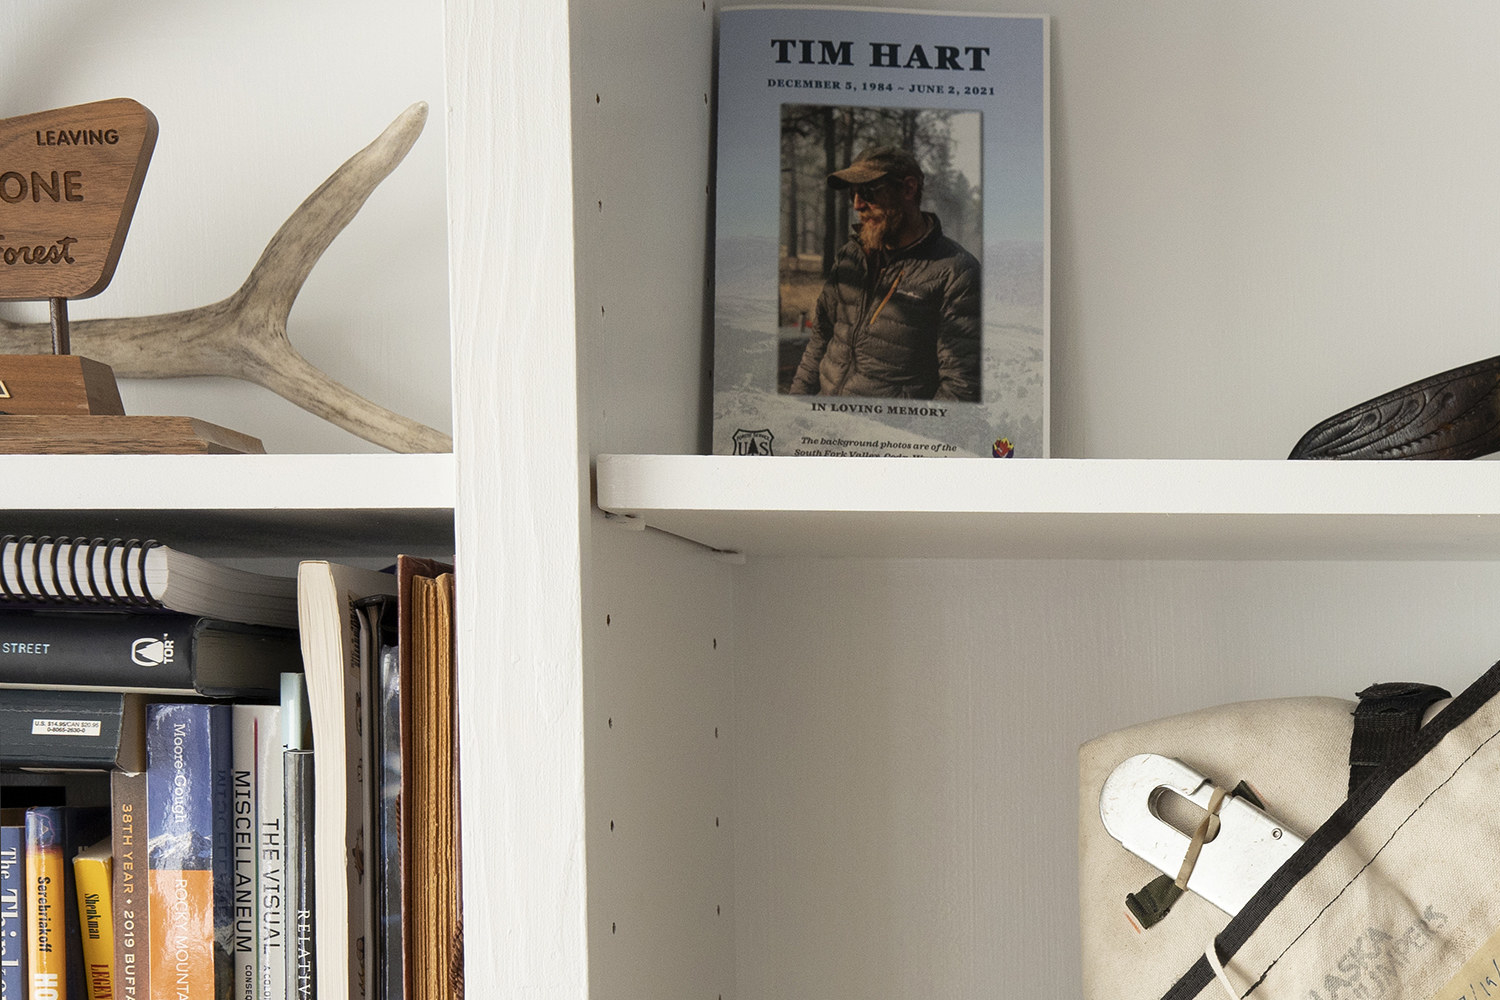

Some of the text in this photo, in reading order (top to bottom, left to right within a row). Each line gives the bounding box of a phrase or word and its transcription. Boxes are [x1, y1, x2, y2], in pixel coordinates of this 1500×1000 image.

[770, 38, 991, 72] TIM HART
[767, 78, 841, 90] DECEMBER
[844, 82, 857, 92] 5,
[861, 82, 893, 92] 1984
[908, 84, 945, 94] JUNE
[947, 86, 961, 96] 2,
[963, 86, 996, 96] 2021
[36, 129, 120, 146] LEAVING
[811, 402, 949, 418] IN LOVING MEMORY
[793, 449, 823, 457] South
[800, 437, 957, 454] The background photos are of the
[2, 642, 51, 655] STREET
[163, 639, 175, 665] TOR
[1, 847, 18, 880] The
[121, 803, 135, 895] 38TH YEAR
[235, 770, 252, 953] MISCELLANEUM
[262, 818, 281, 955] THE VISUAL
[37, 876, 52, 953] Serebriakoff
[84, 893, 102, 940] Shenkman
[174, 879, 189, 934] ROCKY
[123, 910, 136, 948] 2019
